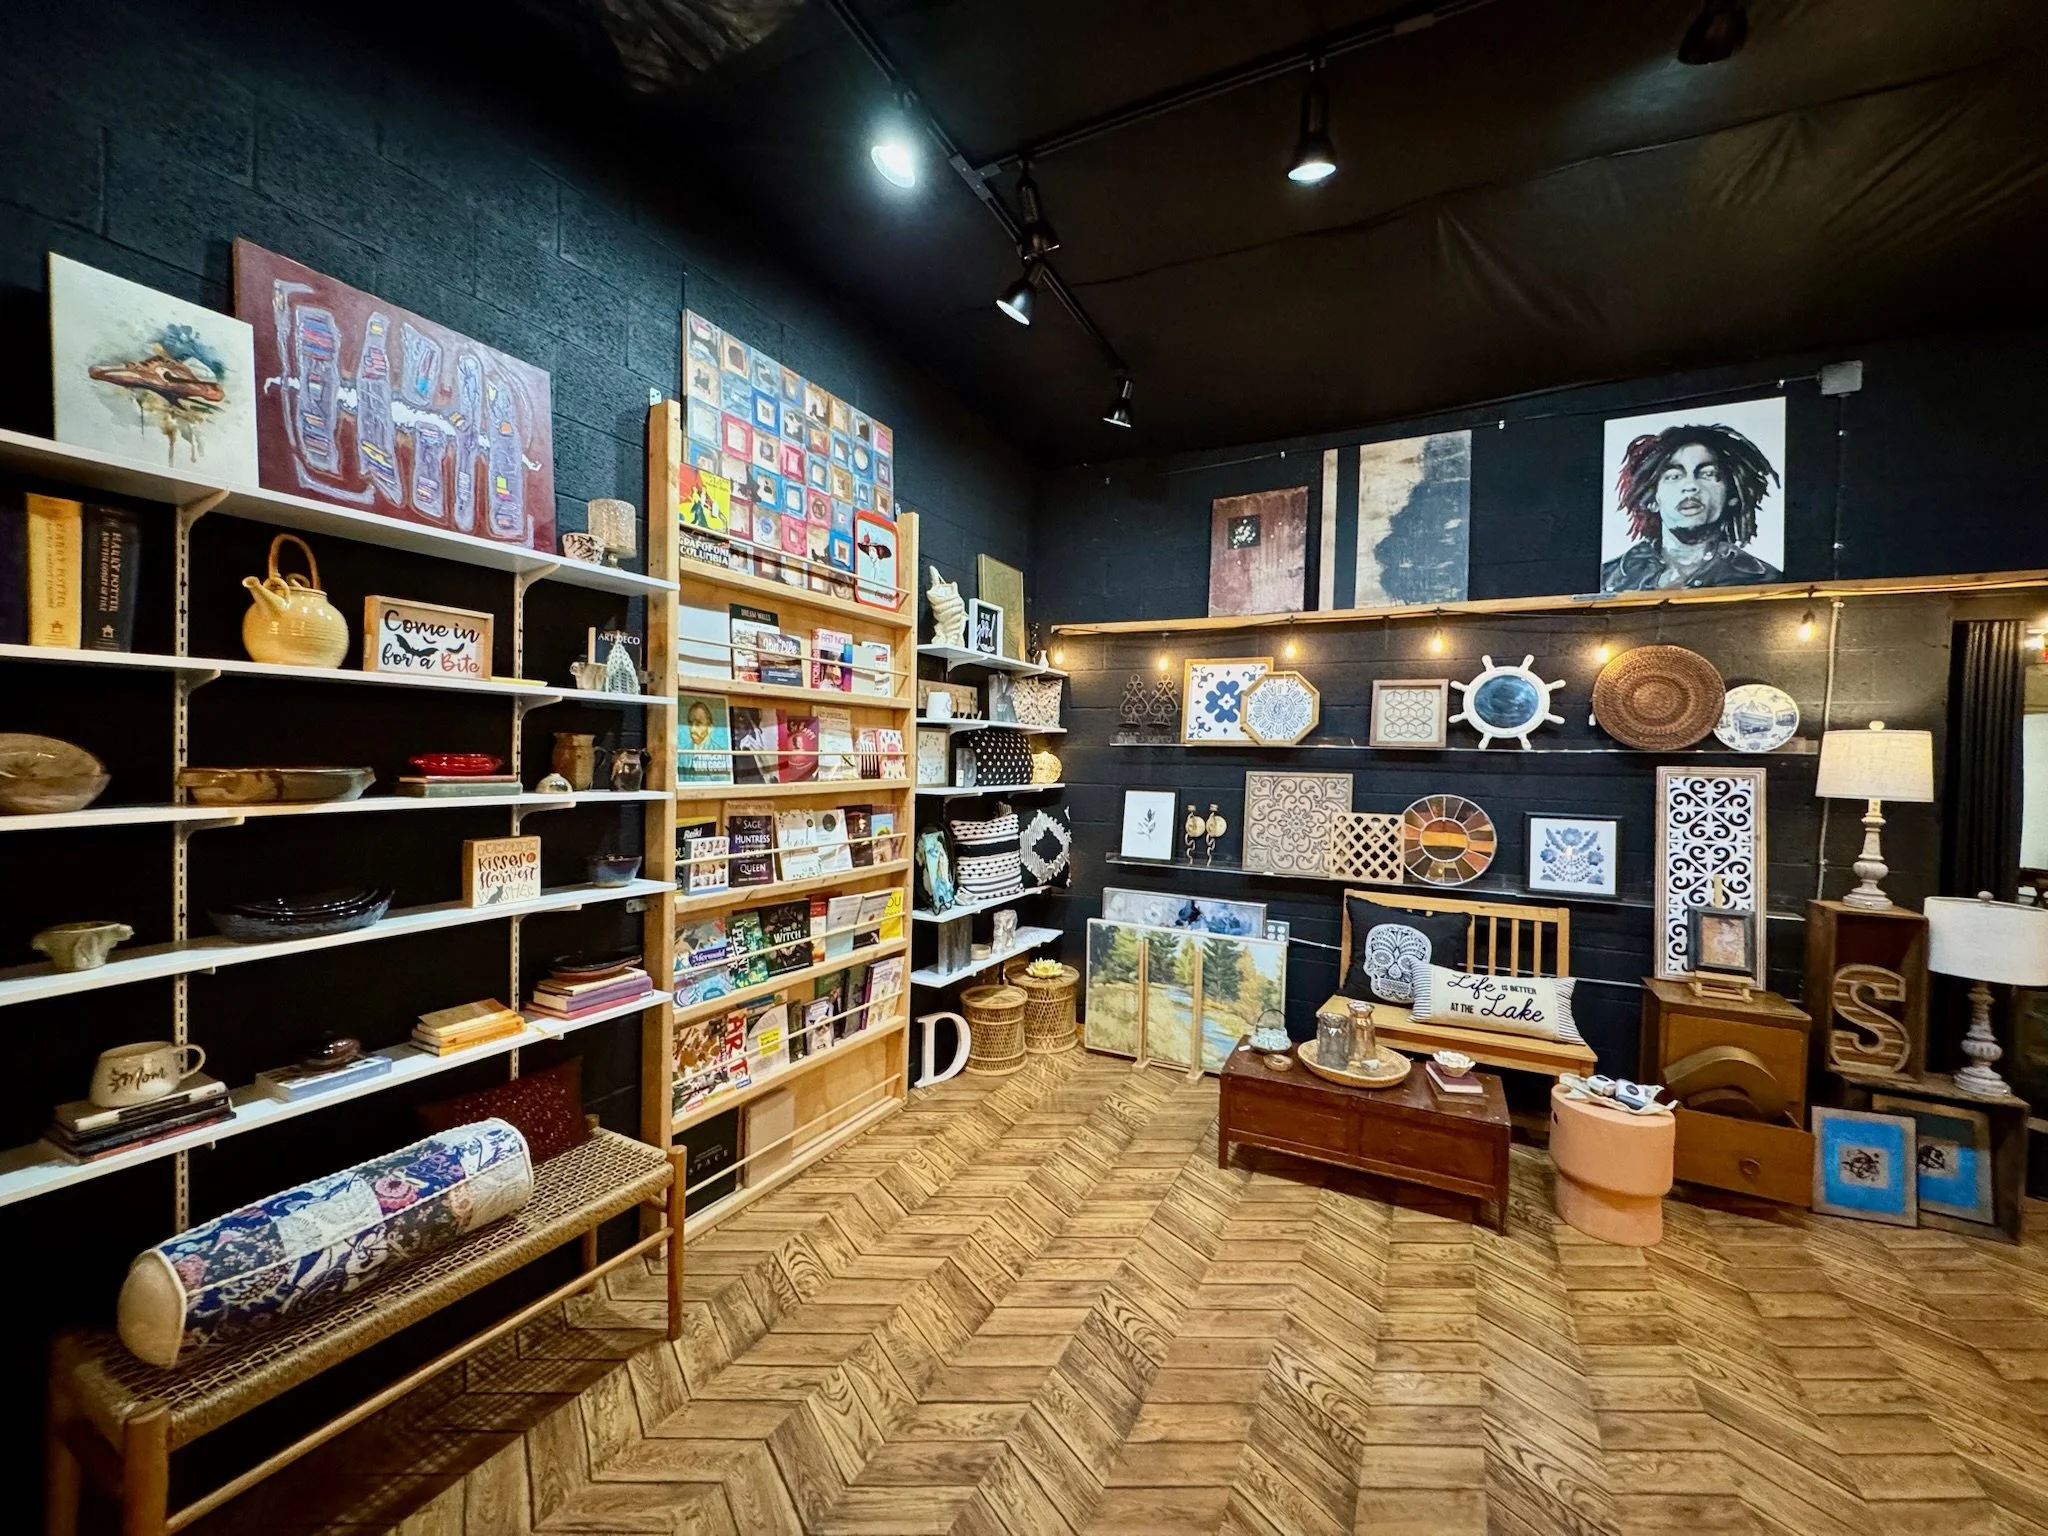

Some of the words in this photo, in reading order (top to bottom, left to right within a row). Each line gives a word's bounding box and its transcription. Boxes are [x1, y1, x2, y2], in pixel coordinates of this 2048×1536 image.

[111, 532, 122, 571] HARRY
[680, 545, 729, 565] COLUMBIA
[109, 573, 120, 612] POTTER
[384, 609, 449, 636] Come
[454, 623, 480, 643] in
[598, 632, 614, 642] ART
[617, 635, 640, 645] DECO
[382, 643, 413, 668] for
[420, 658, 435, 669] a
[441, 653, 480, 673] Bite
[683, 828, 703, 840] Reiki
[743, 820, 761, 829] SAGE
[735, 834, 770, 844] HUNTRESS
[478, 852, 526, 872] Kisses
[740, 863, 766, 875] QUEEN
[480, 863, 538, 889] Harvest
[774, 930, 802, 943] WITCH
[692, 949, 726, 963] Mermaid
[1447, 974, 1496, 1000] Life
[1509, 984, 1537, 995] BETTER
[1450, 1002, 1460, 1012] AT
[1461, 1003, 1474, 1015] THE
[1481, 993, 1545, 1023] Lake
[1832, 963, 1910, 1074] S
[727, 1015, 748, 1076] ART
[914, 1011, 972, 1088] D
[688, 1149, 728, 1175] SPACE
